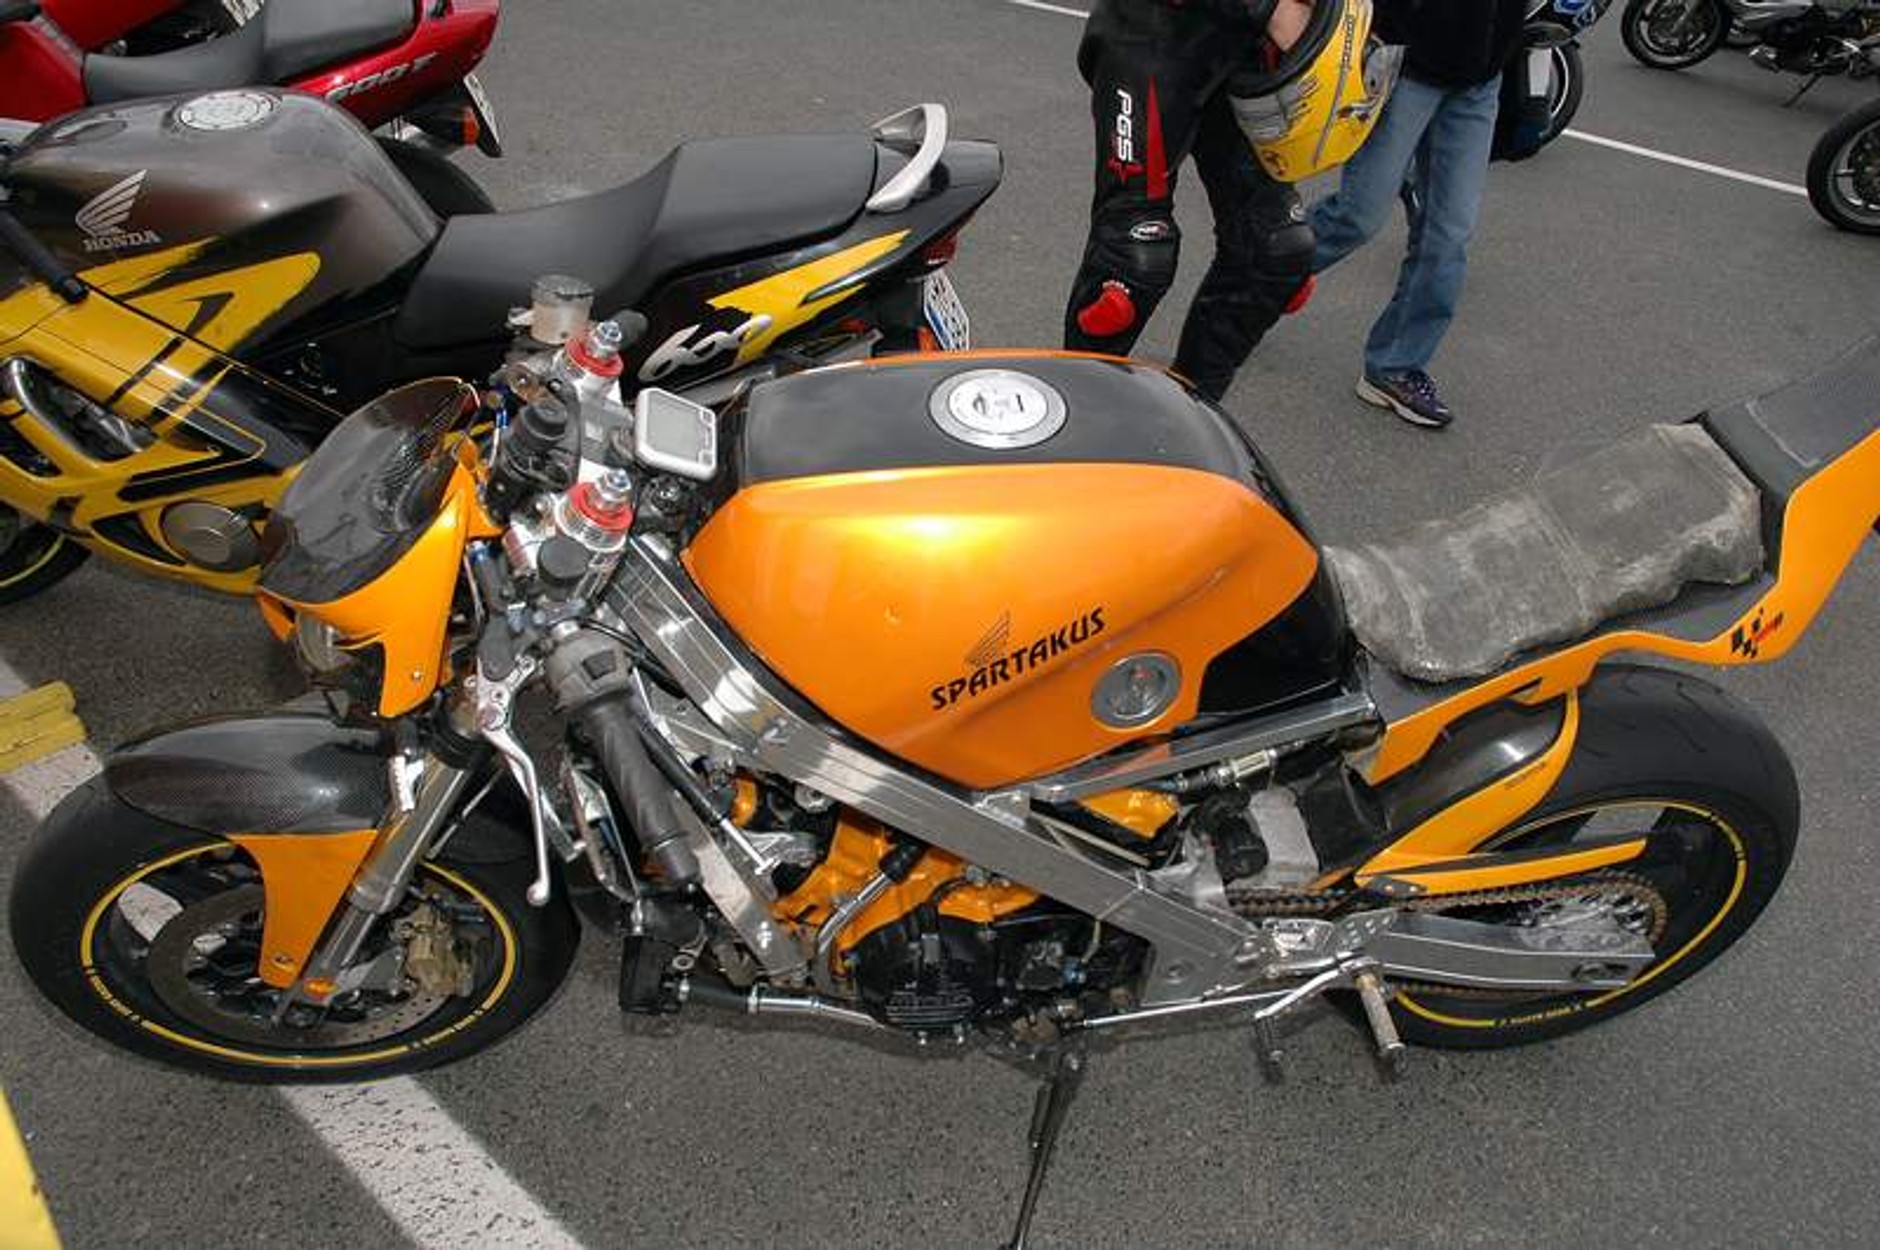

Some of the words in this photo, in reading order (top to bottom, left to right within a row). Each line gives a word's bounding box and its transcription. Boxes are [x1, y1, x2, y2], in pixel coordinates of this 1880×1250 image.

[1116, 88, 1132, 162] PGS
[82, 230, 161, 252] HONDA
[930, 607, 1106, 710] SPARTAKUS
